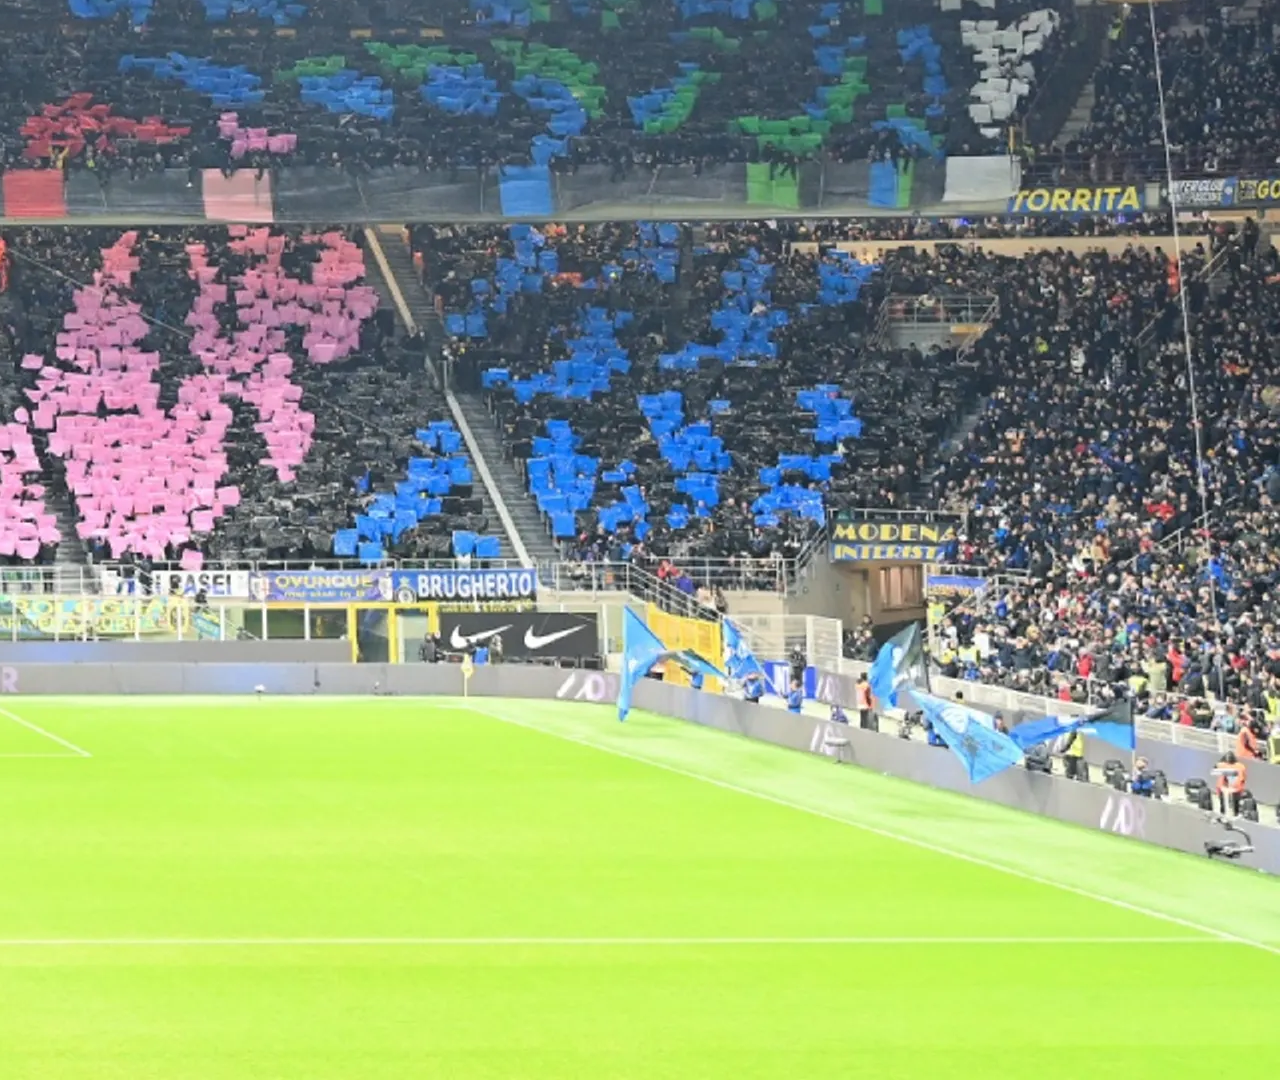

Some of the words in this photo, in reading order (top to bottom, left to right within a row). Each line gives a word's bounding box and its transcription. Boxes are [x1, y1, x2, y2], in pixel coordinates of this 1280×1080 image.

[1012, 185, 1141, 213] TORRITA
[833, 543, 945, 560] INTERIST
[274, 575, 373, 588] OVUNQUE
[417, 572, 532, 598] BRUGHERIO
